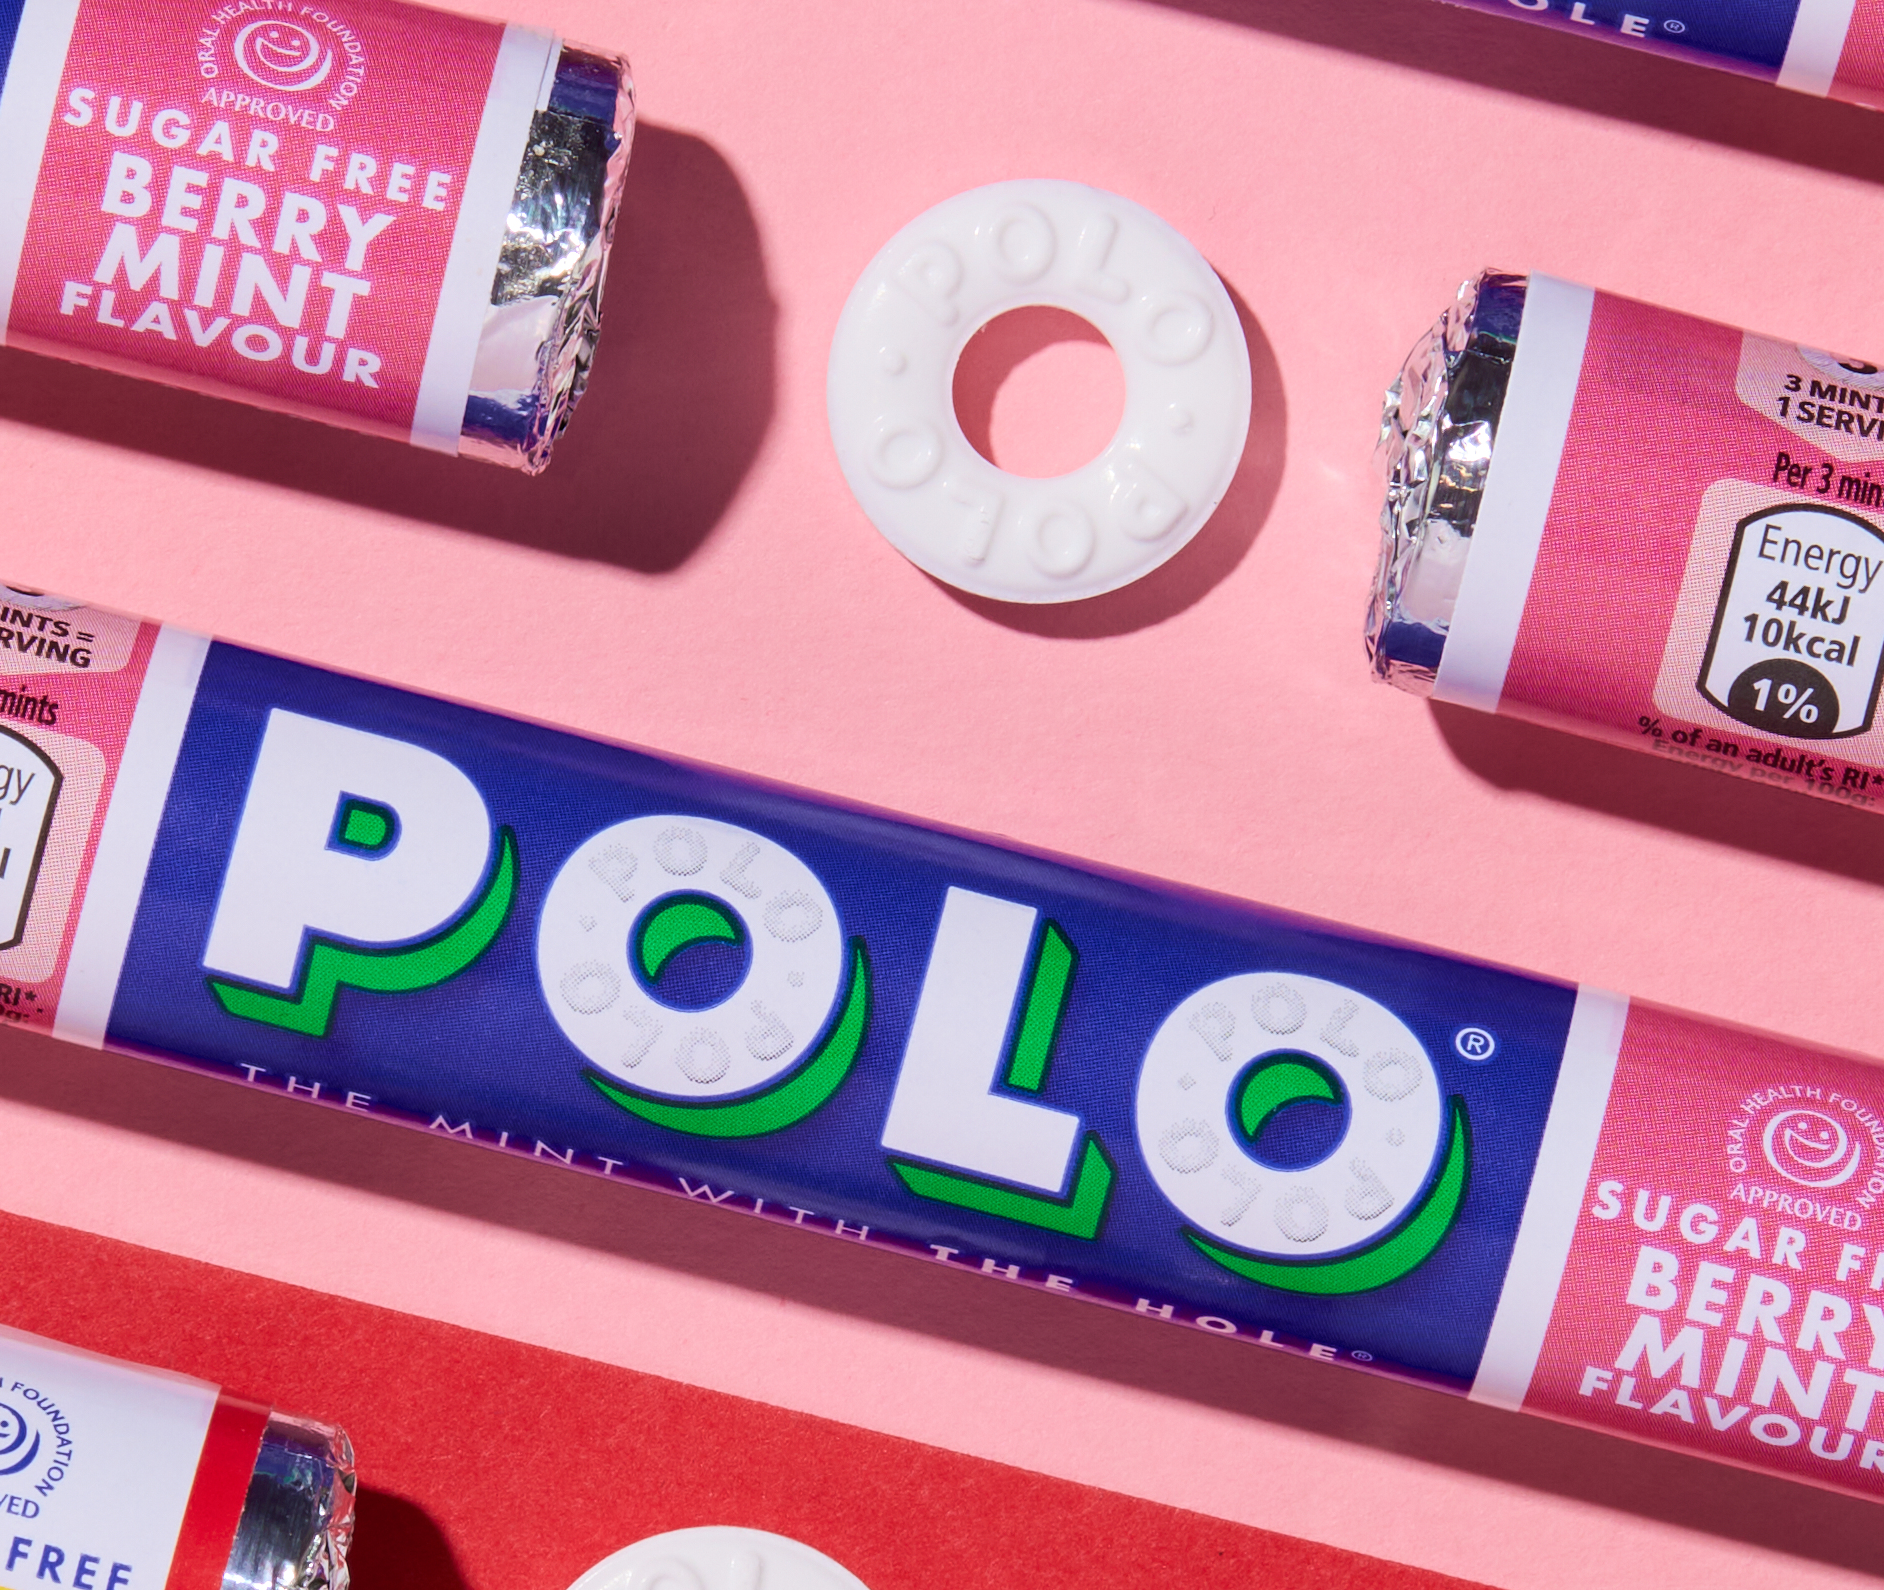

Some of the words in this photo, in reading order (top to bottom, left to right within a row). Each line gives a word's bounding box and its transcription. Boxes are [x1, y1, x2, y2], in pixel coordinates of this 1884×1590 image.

[63, 87, 279, 172] SUGAR
[309, 144, 452, 211] FREE
[201, 87, 335, 132] APPROVED
[101, 151, 396, 272] BERRY
[94, 221, 372, 339] MINT
[60, 280, 382, 388] FLAVOUR
[1758, 523, 1883, 594] Energy
[1766, 580, 1850, 625] 44kJ
[1744, 613, 1861, 667] 10kcal
[1753, 678, 1819, 724] 1%
[1725, 1119, 1750, 1174] ORAL
[1740, 1085, 1821, 1116] HEALTH
[237, 1063, 373, 1113] THE
[428, 1113, 624, 1179] MINT
[675, 1177, 871, 1243] WITH
[927, 1244, 1074, 1295] THE
[1730, 1182, 1862, 1231] APPROVED
[1592, 1179, 1806, 1270] SUGAR
[11, 1381, 73, 1497] FOUNDATION
